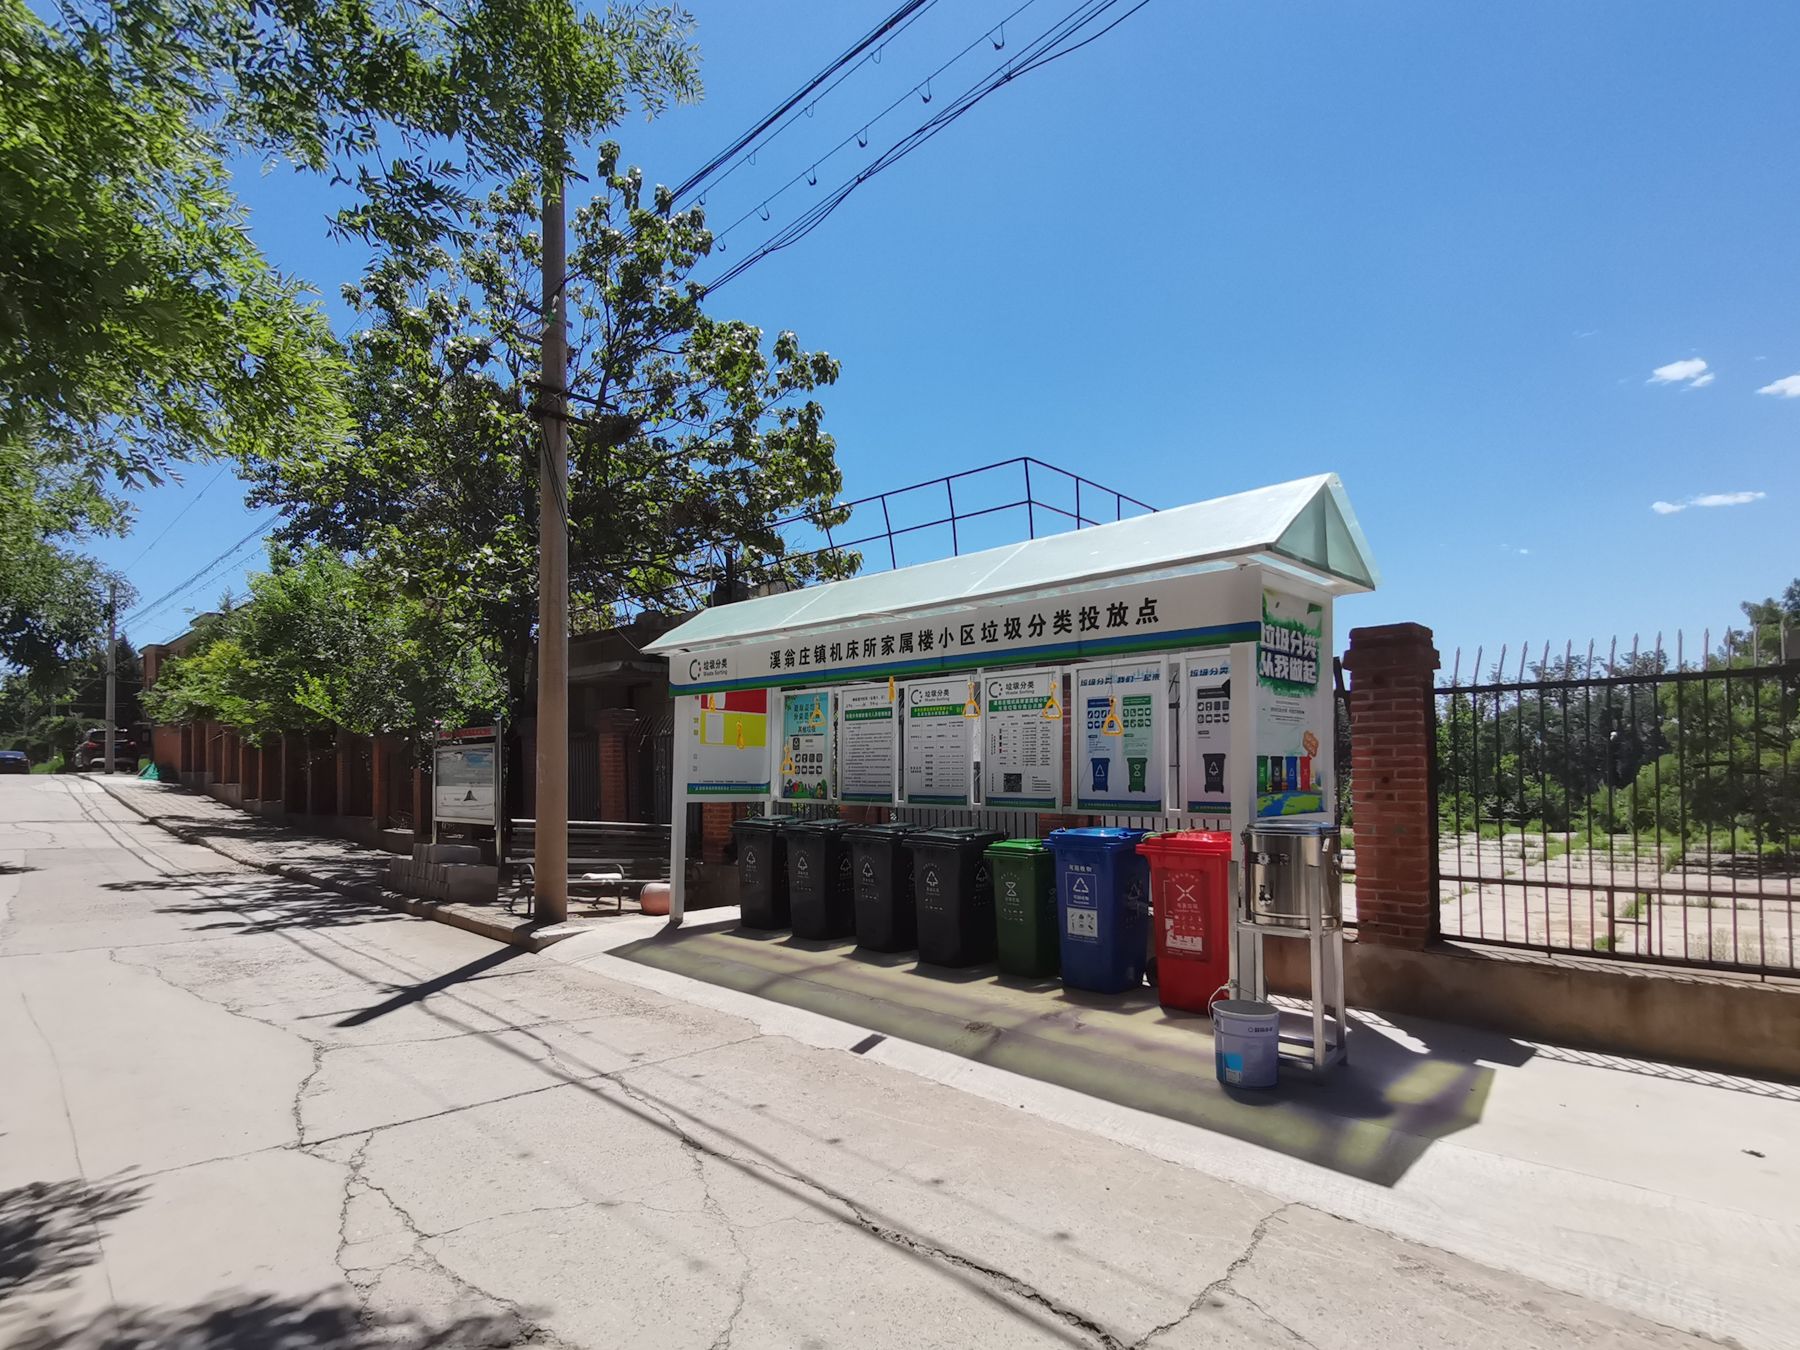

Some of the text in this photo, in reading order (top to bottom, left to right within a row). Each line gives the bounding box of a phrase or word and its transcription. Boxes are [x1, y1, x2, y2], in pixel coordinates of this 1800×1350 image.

[769, 597, 1159, 670] 溪翁庄镇机床所家属楼小区垃圾分类投放点
[1260, 623, 1317, 658] 垃圾分类
[703, 658, 728, 671] 垃圾分类
[1259, 651, 1317, 684] 从我做起
[1190, 666, 1229, 677] 垃圾分类
[1005, 681, 1035, 691] 垃圾分类
[1080, 677, 1112, 687] 垃圾分类
[924, 689, 950, 698] 垃圾分类
